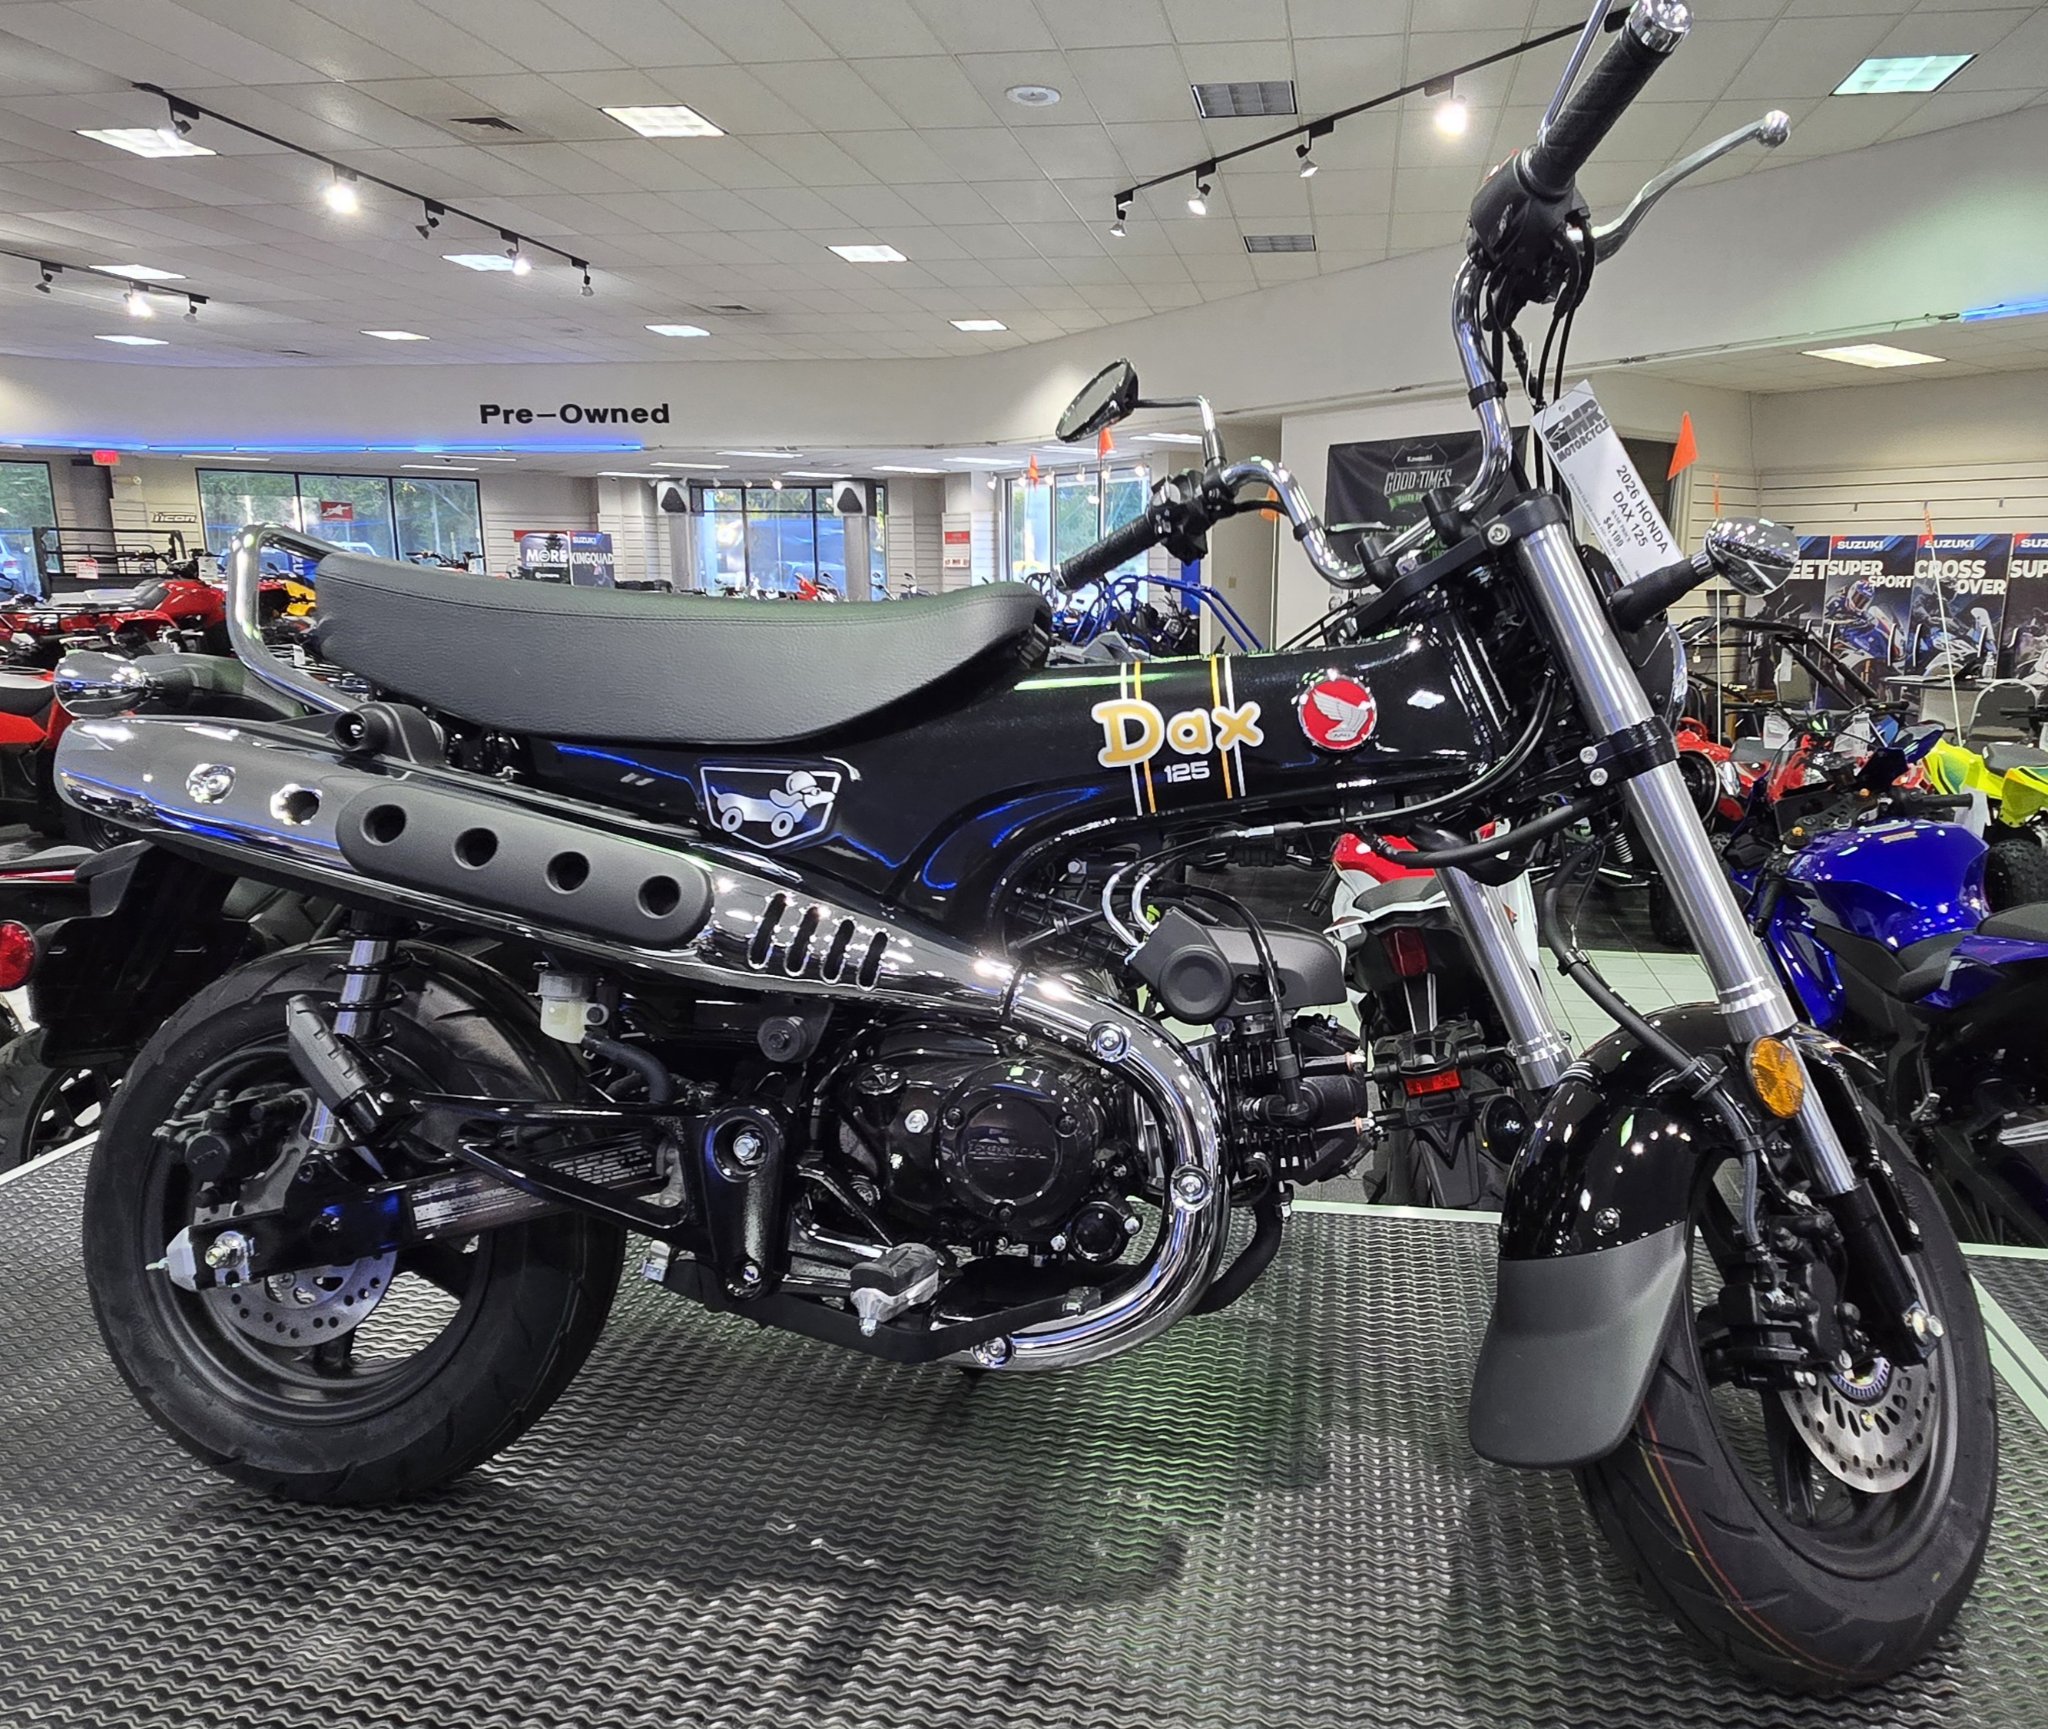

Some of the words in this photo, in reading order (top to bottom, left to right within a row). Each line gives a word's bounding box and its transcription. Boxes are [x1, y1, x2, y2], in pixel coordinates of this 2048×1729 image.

[480, 403, 670, 424] Pre-Owned
[1616, 465, 1641, 500] 2026
[1635, 500, 1670, 554] HONDA
[1612, 491, 1635, 522] DAX
[1630, 523, 1649, 548] 125
[1837, 540, 1885, 550] SUZUKI
[1924, 539, 1976, 549] SUZUKI
[526, 549, 568, 563] MORE
[571, 552, 614, 567] KINGQUAD
[1828, 560, 1884, 576] SUPER
[1914, 560, 1987, 579] CROSS
[1867, 575, 1915, 589] SPORT
[1956, 579, 2007, 595] OVER
[1091, 698, 1265, 768] Dax
[1163, 760, 1211, 784] 125
